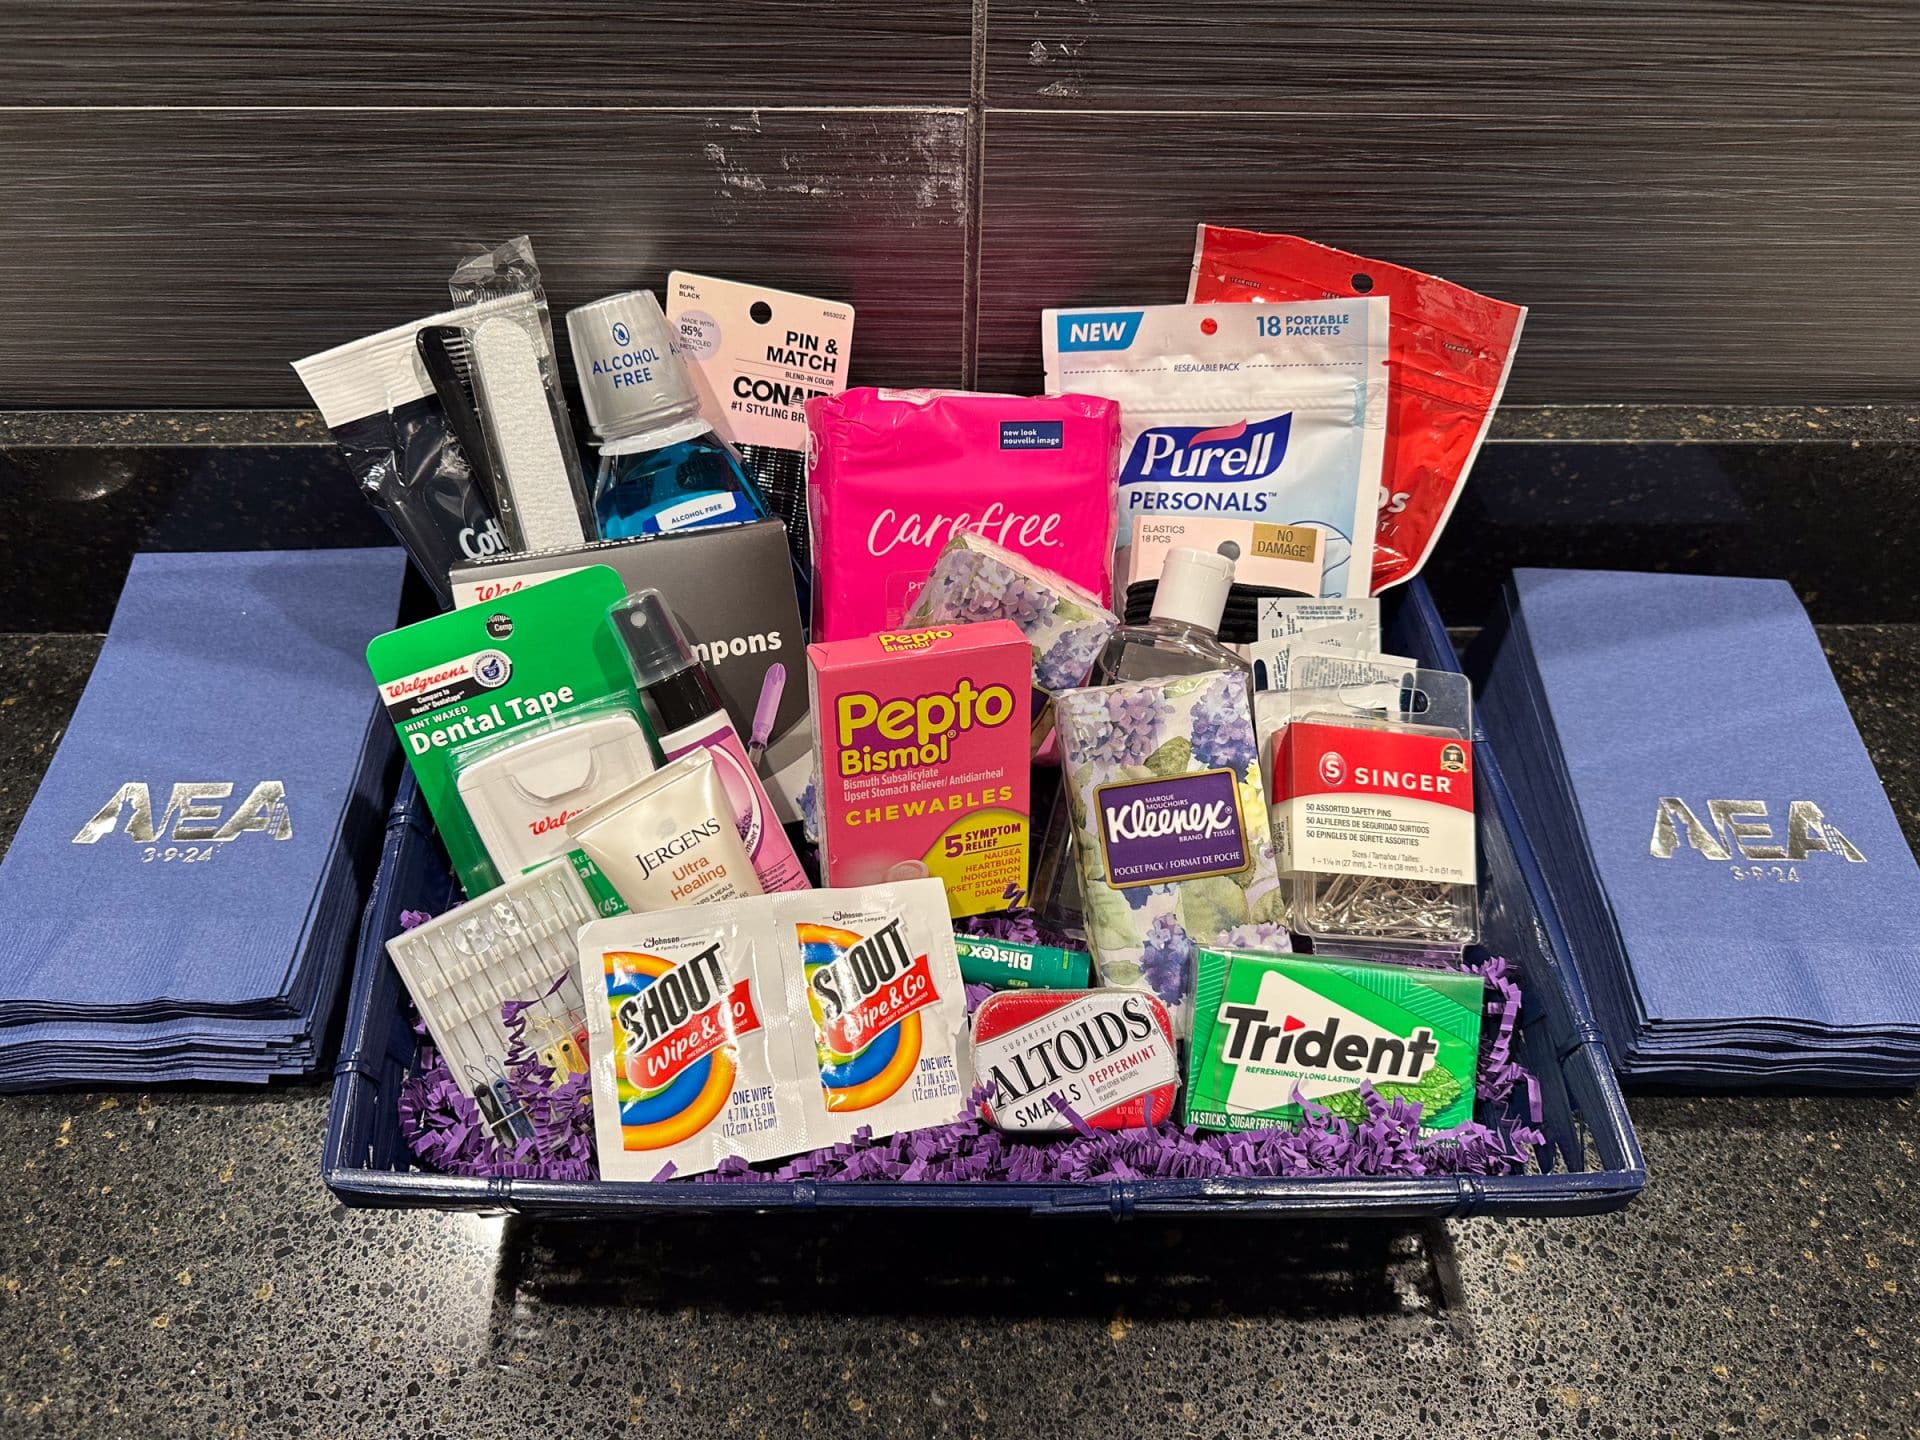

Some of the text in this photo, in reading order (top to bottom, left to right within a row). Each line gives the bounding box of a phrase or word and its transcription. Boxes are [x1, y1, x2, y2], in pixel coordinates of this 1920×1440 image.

[679, 290, 701, 300] BLACK
[681, 317, 715, 328] MADE WITH
[1256, 315, 1282, 337] 18
[1286, 314, 1349, 325] PORTABLE
[680, 325, 703, 338] 95%
[1070, 322, 1127, 343] NEW
[1286, 325, 1340, 336] PACKETS
[680, 336, 712, 348] RECYCLED
[786, 330, 839, 355] PIN &
[592, 347, 660, 375] ALCOHOL
[766, 346, 837, 373] MATCH
[1174, 362, 1240, 373] RESEALABLE PACK
[613, 367, 653, 389] FREE
[785, 371, 834, 387] BLEND-IN COLOR
[731, 401, 743, 412] #1
[746, 403, 789, 420] STYLING
[1003, 436, 1060, 446] nouvelle image
[1140, 432, 1275, 478] Purell
[671, 503, 723, 524] ALCOHOL FREE
[1142, 525, 1185, 534] ELASTICS
[1142, 535, 1171, 544] 18 PCS
[1277, 530, 1294, 542] NO
[690, 631, 782, 665] mpons
[878, 629, 953, 647] Pepto
[884, 640, 930, 653] Bismol
[386, 664, 469, 698] Walgreens
[404, 705, 468, 733] MINT WAXED
[408, 685, 574, 755] Dental Tape
[838, 680, 1013, 746] Pepto
[843, 768, 939, 790] Bismuth Subsalicylate
[843, 791, 869, 803] Upset
[871, 782, 909, 799] Stomach
[949, 767, 1004, 786] Antidiarrheal
[1355, 767, 1452, 793] SINGER
[845, 786, 1013, 826] CHEWABLES
[1145, 794, 1175, 803] MARQUE
[1146, 799, 1189, 810] MOUCHOIRS
[1306, 803, 1392, 818] 50 ASSORTED SAFETY PINS
[965, 823, 1021, 842] SYMPTOM
[1306, 816, 1430, 835] 50 ALFILERES DE SEGURIDAD SURTIDOS
[945, 834, 964, 858] 5
[965, 838, 998, 851] RELIEF
[1179, 829, 1236, 843] BRAND TISSUE
[1306, 830, 1315, 838] 50
[1316, 831, 1348, 841] EPINGLES
[1349, 834, 1358, 842] DE
[1385, 837, 1420, 847] ASSORTIES
[635, 818, 721, 881] JERGENS
[984, 848, 1022, 861] NAUSEA
[672, 857, 710, 882] Ultra
[961, 865, 1021, 883] INDIGESTION
[965, 857, 1021, 873] HEARTBURN
[1114, 864, 1143, 877] POCKET
[1144, 862, 1165, 872] PACK
[1170, 857, 1201, 870] FORMAT
[1202, 856, 1213, 865] DE
[1214, 852, 1241, 863] POCHE
[670, 864, 727, 901] Healing
[974, 883, 1021, 898] DIARRHA
[975, 874, 1021, 889] STOMACH
[969, 944, 1033, 971] Blistex
[619, 942, 727, 1053] SHOUT
[889, 986, 905, 1009] &
[903, 974, 926, 999] Go
[1002, 1003, 1094, 1053] SUGARFREE MINTS
[647, 1033, 700, 1077] Wipe
[701, 1015, 717, 1040] &
[1225, 1006, 1436, 1078] Trident
[920, 1055, 953, 1072] ONE WIPE
[988, 997, 1152, 1110] ALTOIDS
[1089, 1045, 1156, 1087] PEPPERMINT
[1245, 1066, 1361, 1085] REFRESHINGLY LONG LASTING
[732, 1086, 773, 1106] ONE WIPE
[1015, 1083, 1082, 1128] SMALS
[1190, 1111, 1200, 1124] 14
[1200, 1112, 1227, 1127] STICKS
[1230, 1115, 1257, 1129] SUGAR
[1256, 1119, 1274, 1131] FREE
